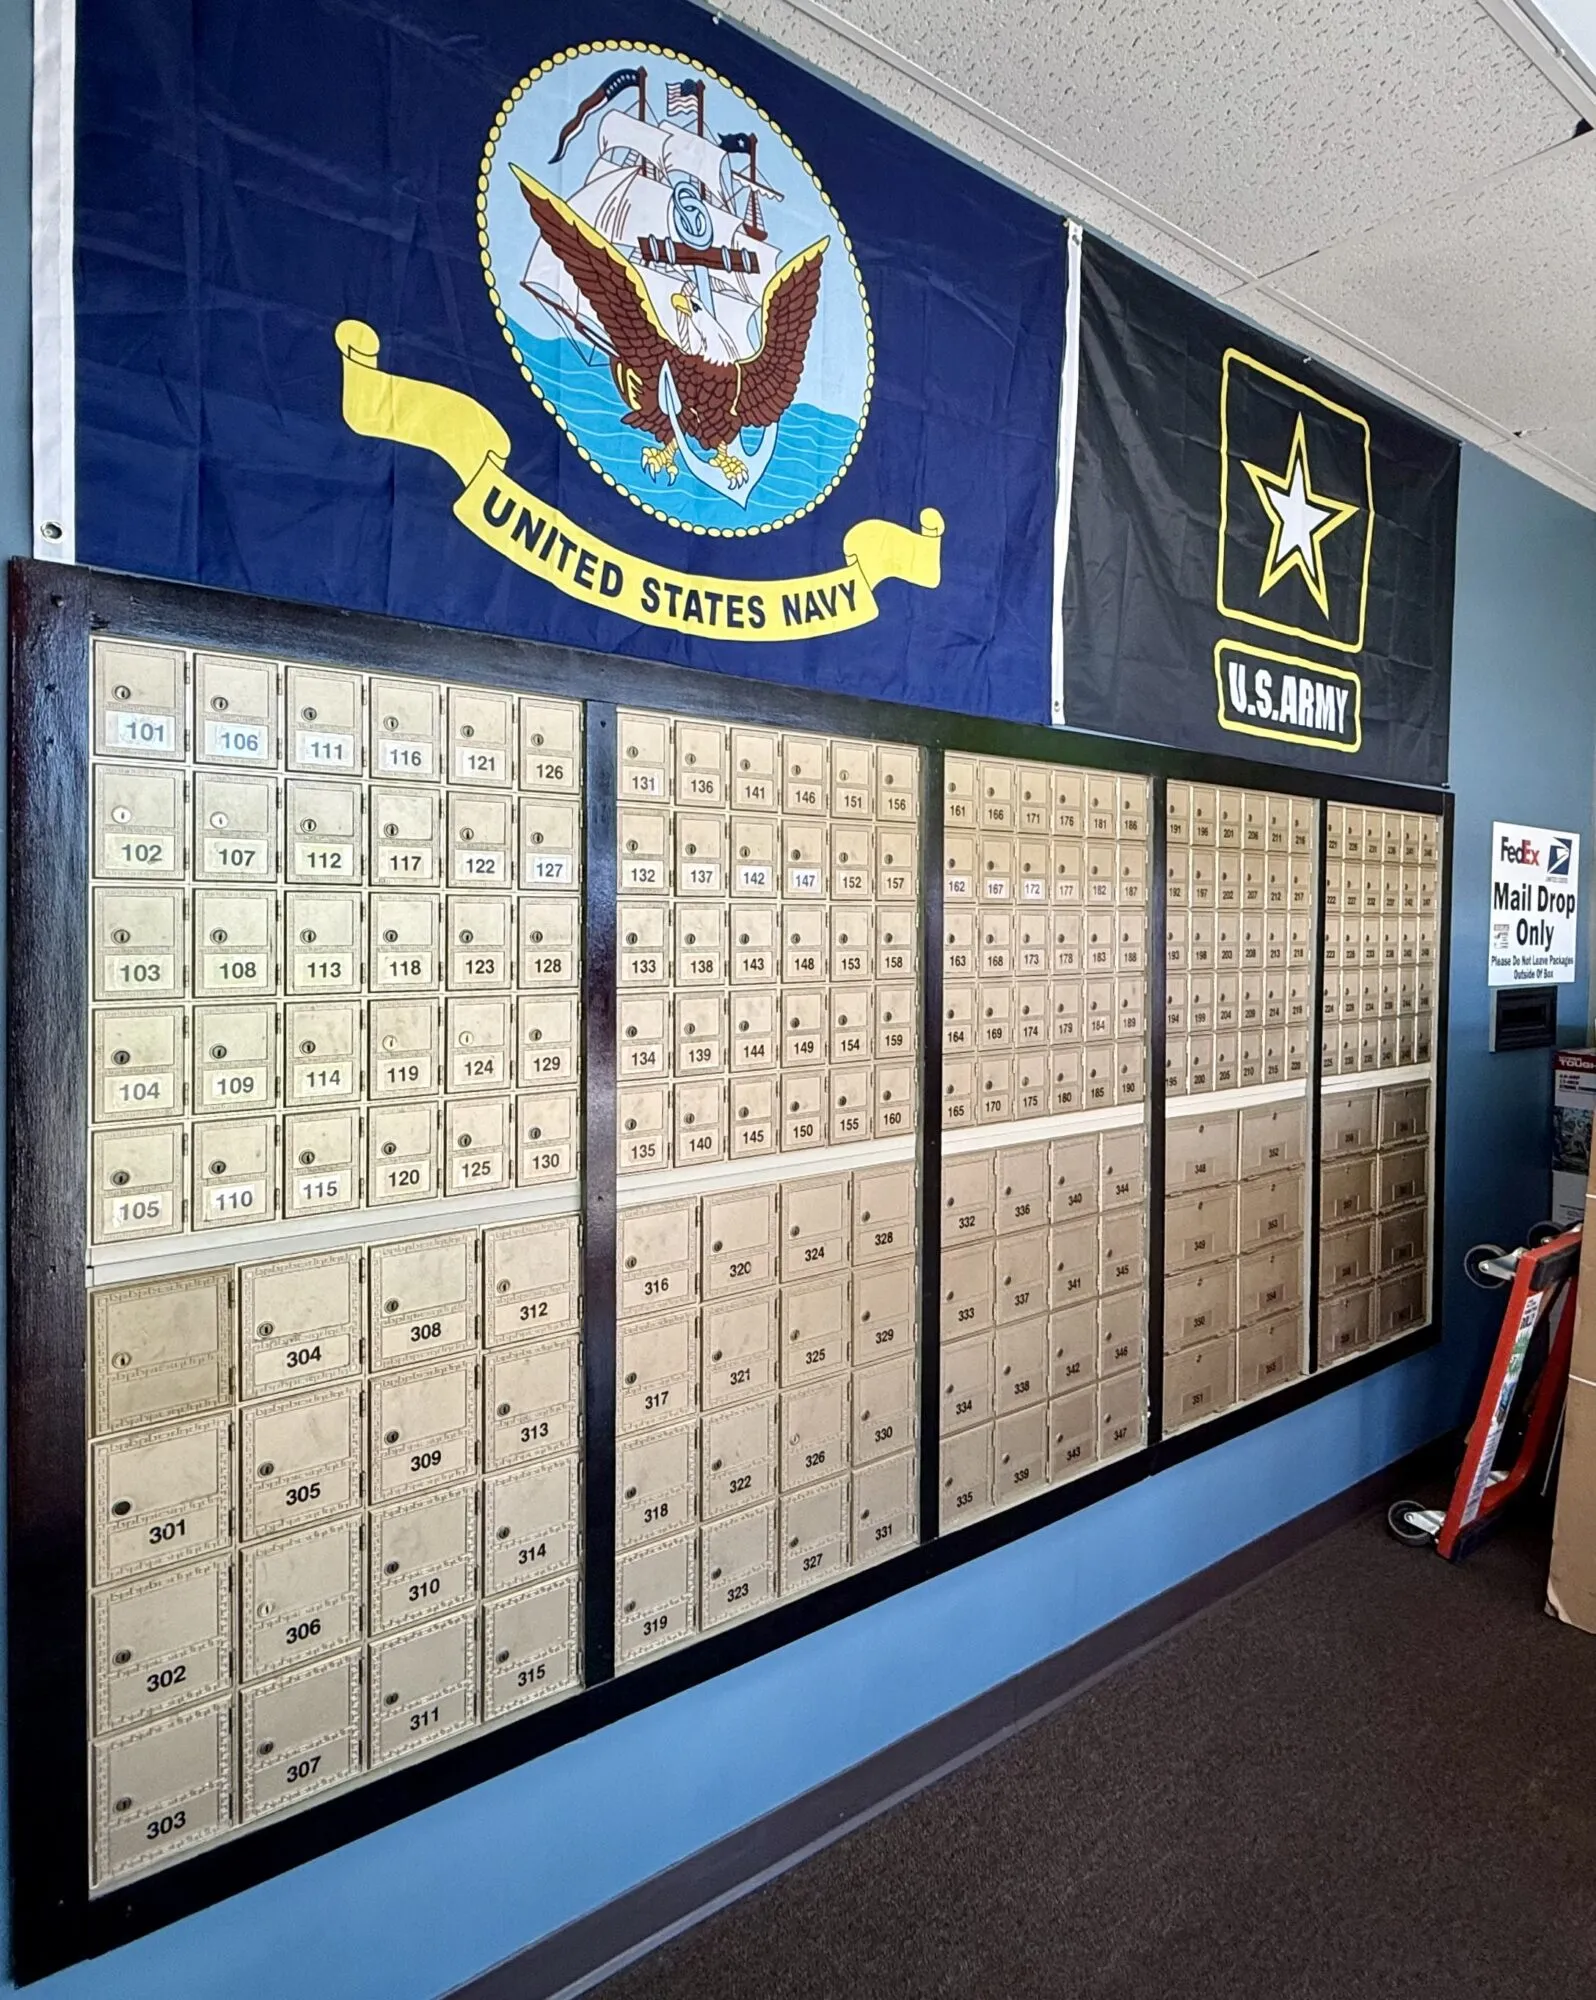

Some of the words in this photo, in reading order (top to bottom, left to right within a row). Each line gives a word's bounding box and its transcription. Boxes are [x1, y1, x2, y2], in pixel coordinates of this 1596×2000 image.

[482, 486, 624, 598] UNITED
[641, 577, 766, 629] STATES
[783, 580, 856, 626] NAVY
[125, 721, 164, 742] 101
[220, 731, 258, 751] 106
[310, 741, 342, 760] 111
[390, 748, 421, 766] 116
[467, 754, 495, 771] 121
[536, 763, 563, 780] 126
[632, 775, 654, 791] 131
[690, 779, 714, 794] 136
[745, 785, 764, 799] 141
[795, 790, 816, 804] 146
[844, 794, 862, 808] 151
[888, 797, 906, 810] 156
[950, 804, 965, 817] 161
[1026, 812, 1040, 824] 171
[1094, 818, 1106, 829] 181
[121, 843, 162, 864] 102
[218, 848, 256, 866] 107
[307, 851, 342, 868] 112
[1500, 836, 1540, 867] FedEx
[390, 855, 421, 871] 117
[465, 858, 495, 874] 122
[536, 862, 563, 878] 127
[631, 867, 655, 883] 132
[690, 869, 713, 883] 137
[743, 871, 765, 885] 142
[795, 874, 815, 887] 147
[842, 876, 862, 888] 152
[886, 877, 904, 889] 157
[948, 880, 965, 892] 162
[988, 883, 1004, 895] 167
[1024, 883, 1040, 895] 172
[1059, 884, 1074, 896] 177
[1493, 882, 1532, 912] Mail
[1537, 885, 1576, 919] Drop
[1516, 918, 1555, 952] Only
[465, 958, 494, 974] 123
[534, 958, 562, 973] 128
[631, 959, 656, 974] 133
[690, 959, 713, 974] 138
[743, 957, 764, 971] 143
[794, 957, 815, 970] 148
[841, 957, 860, 970] 153
[885, 956, 903, 968] 158
[949, 954, 966, 967] 163
[987, 955, 1003, 966] 168
[1024, 953, 1039, 965] 173
[1491, 955, 1511, 966] Please
[1513, 954, 1520, 966] Do
[1522, 955, 1531, 965] Not
[1532, 955, 1548, 966] Leave
[1549, 954, 1574, 967] Packages
[119, 964, 160, 982] 103
[219, 961, 256, 979] 108
[307, 961, 341, 978] 113
[389, 959, 421, 976] 118
[1514, 969, 1535, 980] Outside
[1536, 968, 1543, 978] Of
[1544, 968, 1554, 979] Box
[947, 1030, 964, 1042] 164
[986, 1027, 1002, 1040] 169
[1023, 1025, 1038, 1037] 174
[793, 1040, 814, 1054] 149
[840, 1038, 860, 1052] 154
[885, 1033, 903, 1046] 159
[631, 1051, 656, 1066] 134
[688, 1047, 711, 1063] 139
[743, 1043, 765, 1058] 144
[464, 1059, 494, 1076] 124
[533, 1056, 560, 1072] 129
[306, 1069, 340, 1087] 114
[386, 1065, 418, 1083] 119
[118, 1081, 160, 1101] 104
[217, 1076, 254, 1095] 109
[1090, 1086, 1104, 1098] 185
[1122, 1082, 1135, 1093] 190
[1023, 1094, 1038, 1107] 175
[1057, 1091, 1072, 1103] 180
[947, 1104, 965, 1117] 165
[985, 1099, 1001, 1112] 170
[840, 1117, 859, 1131] 155
[883, 1111, 901, 1125] 160
[742, 1129, 764, 1144] 145
[792, 1123, 813, 1138] 150
[631, 1142, 656, 1159] 135
[689, 1136, 712, 1152] 140
[461, 1160, 491, 1178] 125
[532, 1153, 560, 1170] 130
[388, 1168, 420, 1187] 120
[303, 1180, 337, 1200] 115
[1115, 1182, 1129, 1195] 344
[216, 1190, 253, 1211] 110
[119, 1200, 160, 1221] 105
[1014, 1203, 1030, 1217] 336
[958, 1215, 975, 1229] 332
[874, 1231, 893, 1246] 328
[804, 1246, 824, 1262] 324
[729, 1260, 752, 1278] 320
[1115, 1264, 1129, 1277] 345
[644, 1277, 669, 1295] 316
[1067, 1277, 1080, 1291] 341
[1014, 1291, 1030, 1306] 337
[519, 1301, 548, 1321] 312
[958, 1306, 974, 1322] 333
[410, 1321, 442, 1342] 308
[875, 1328, 894, 1344] 329
[286, 1345, 322, 1368] 304
[805, 1347, 825, 1364] 325
[730, 1367, 750, 1385] 321
[1065, 1361, 1080, 1376] 342
[644, 1390, 669, 1410] 317
[955, 1399, 972, 1415] 334
[520, 1421, 548, 1442] 313
[874, 1425, 893, 1443] 330
[1113, 1426, 1127, 1441] 347
[410, 1449, 441, 1472] 309
[805, 1450, 825, 1468] 326
[1066, 1446, 1080, 1461] 343
[729, 1474, 751, 1494] 322
[285, 1481, 320, 1506] 305
[956, 1491, 973, 1508] 335
[644, 1502, 668, 1523] 318
[149, 1518, 185, 1544] 301
[875, 1523, 892, 1541] 331
[518, 1542, 546, 1564] 314
[802, 1552, 823, 1571] 327
[408, 1577, 440, 1602] 310
[727, 1582, 749, 1603] 323
[286, 1618, 321, 1644] 306
[643, 1614, 667, 1636] 319
[146, 1664, 186, 1692] 302
[517, 1663, 545, 1687] 315
[409, 1706, 438, 1731] 311
[286, 1755, 321, 1783] 307
[146, 1810, 186, 1840] 303
